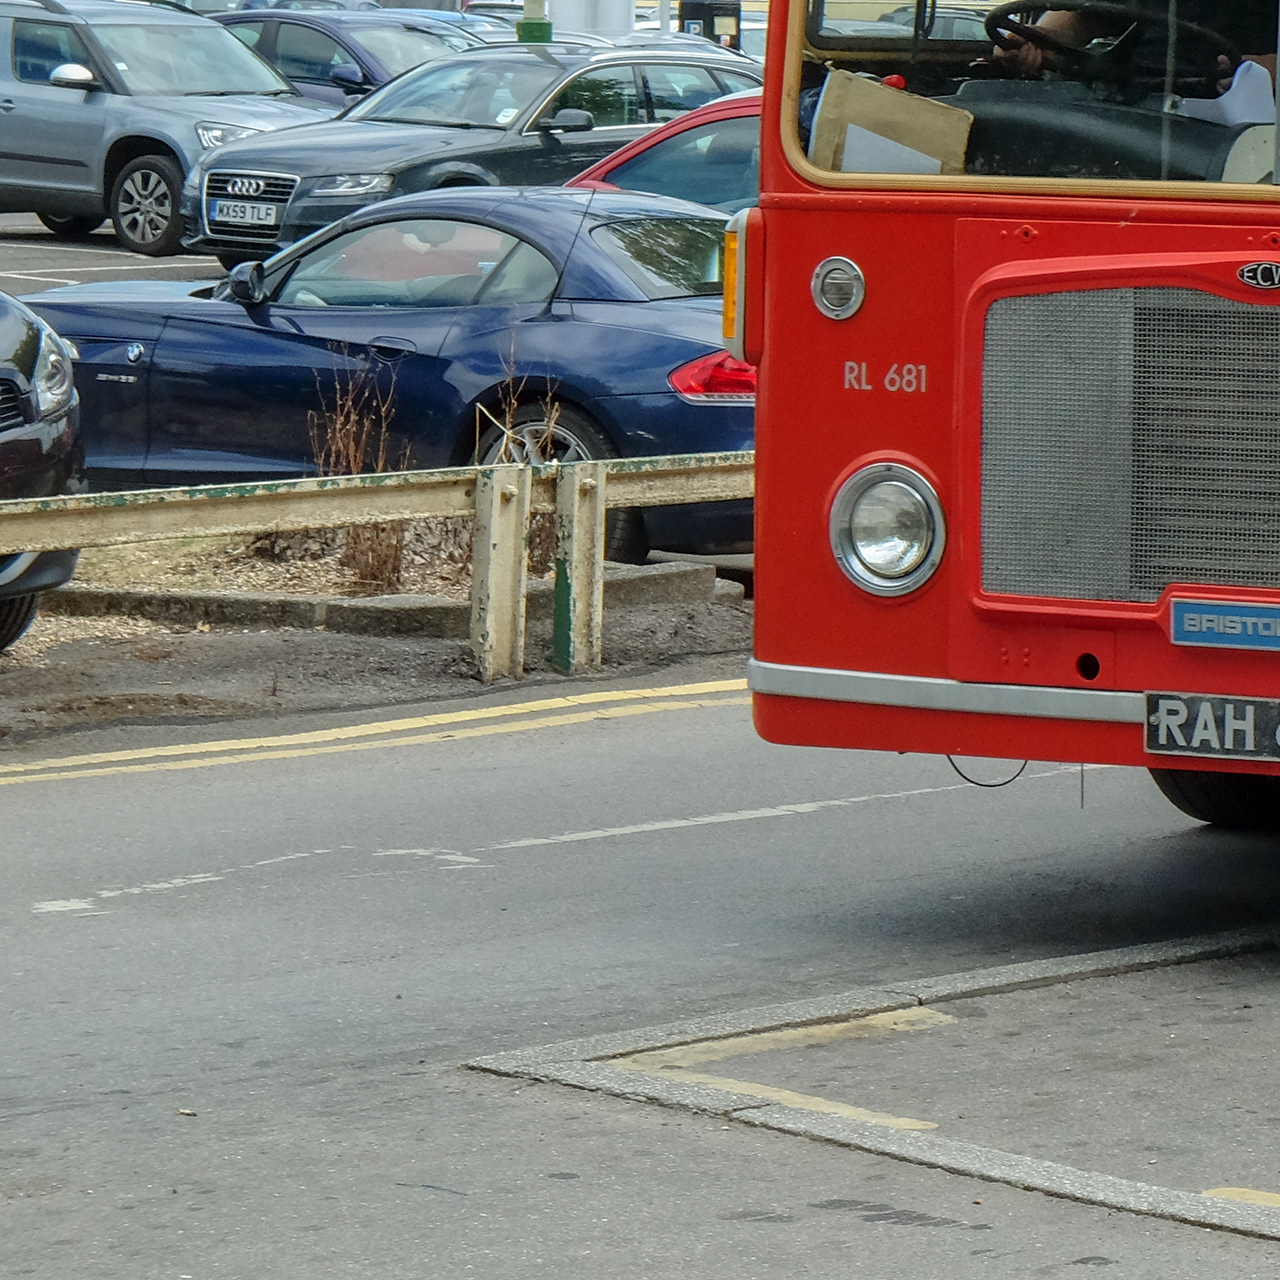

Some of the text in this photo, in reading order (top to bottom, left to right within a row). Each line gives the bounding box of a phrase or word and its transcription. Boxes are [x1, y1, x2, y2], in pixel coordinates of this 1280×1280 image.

[250, 206, 273, 221] TLF
[844, 361, 927, 393] RL 681
[1158, 700, 1256, 751] RAH
